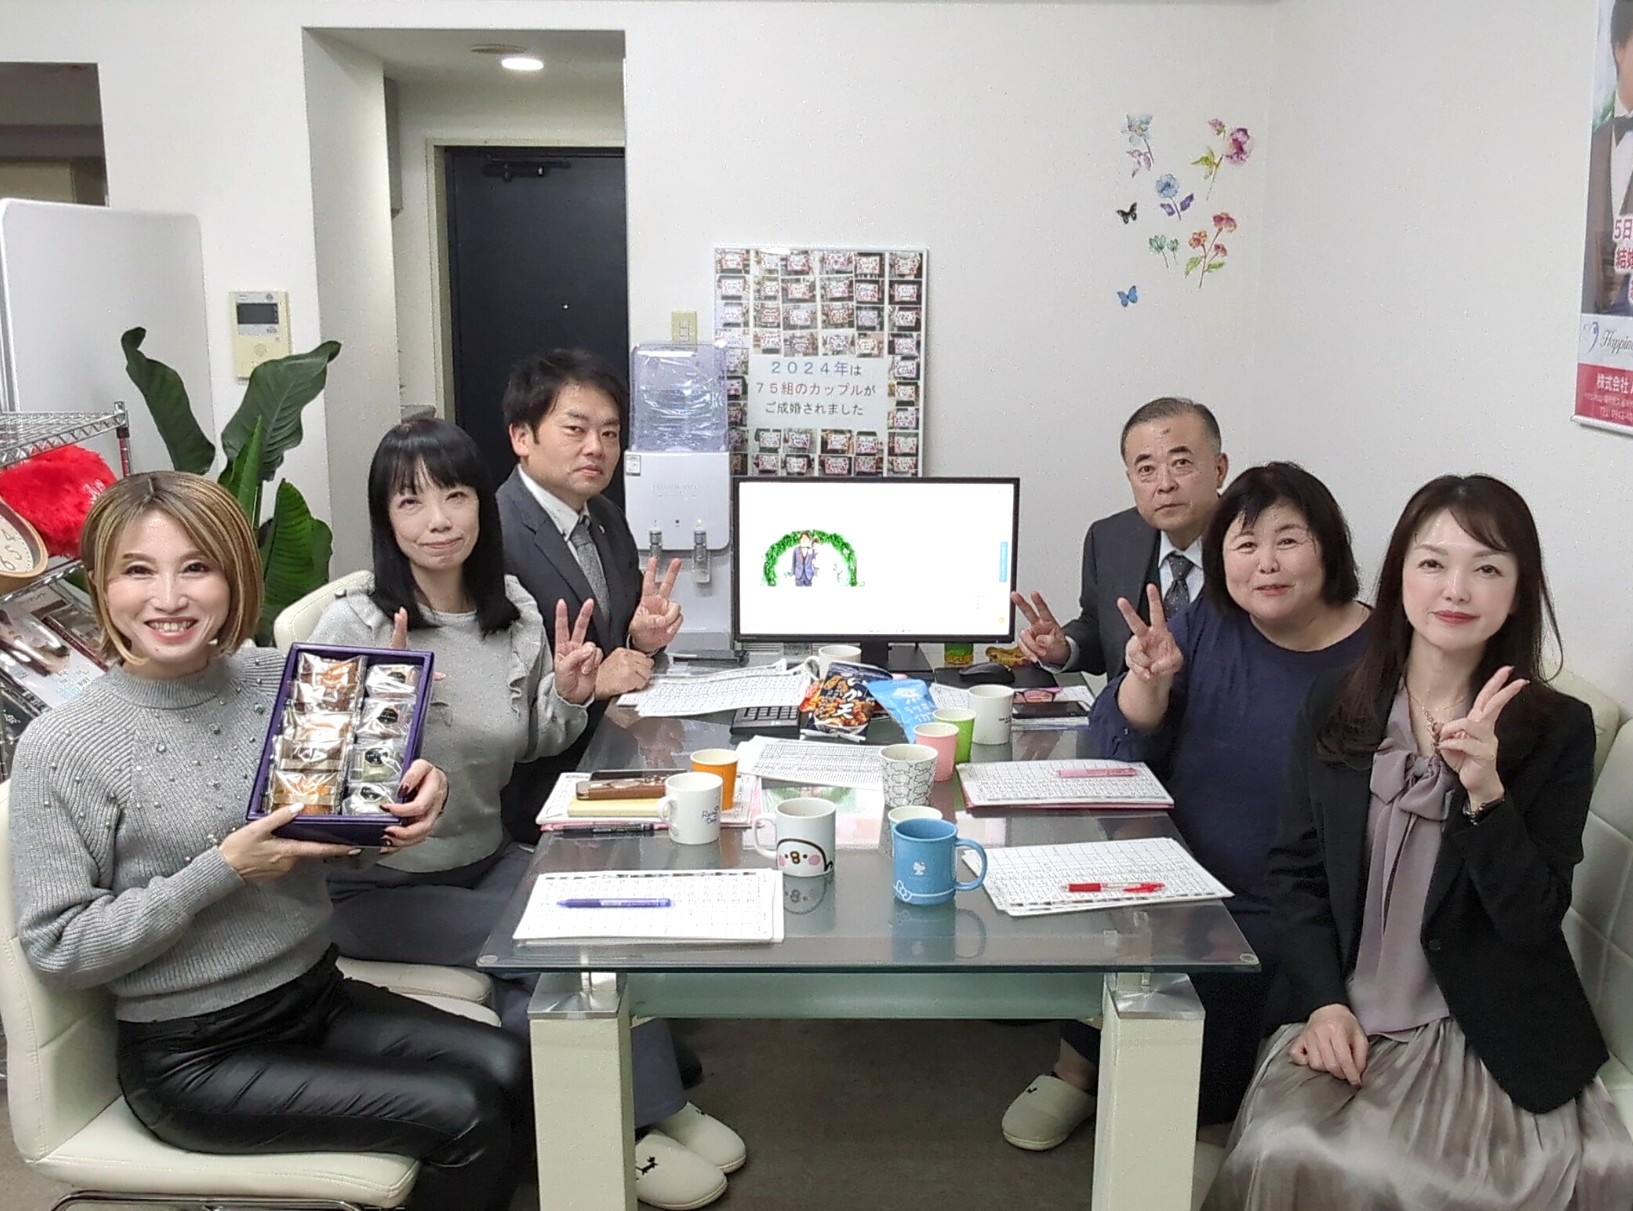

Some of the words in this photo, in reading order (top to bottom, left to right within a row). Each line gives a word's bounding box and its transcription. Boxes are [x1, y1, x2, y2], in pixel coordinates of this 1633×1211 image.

[771, 360, 862, 377] 2024年は
[755, 382, 876, 396] 75組のカップルが
[765, 402, 863, 416] ご成婚されました
